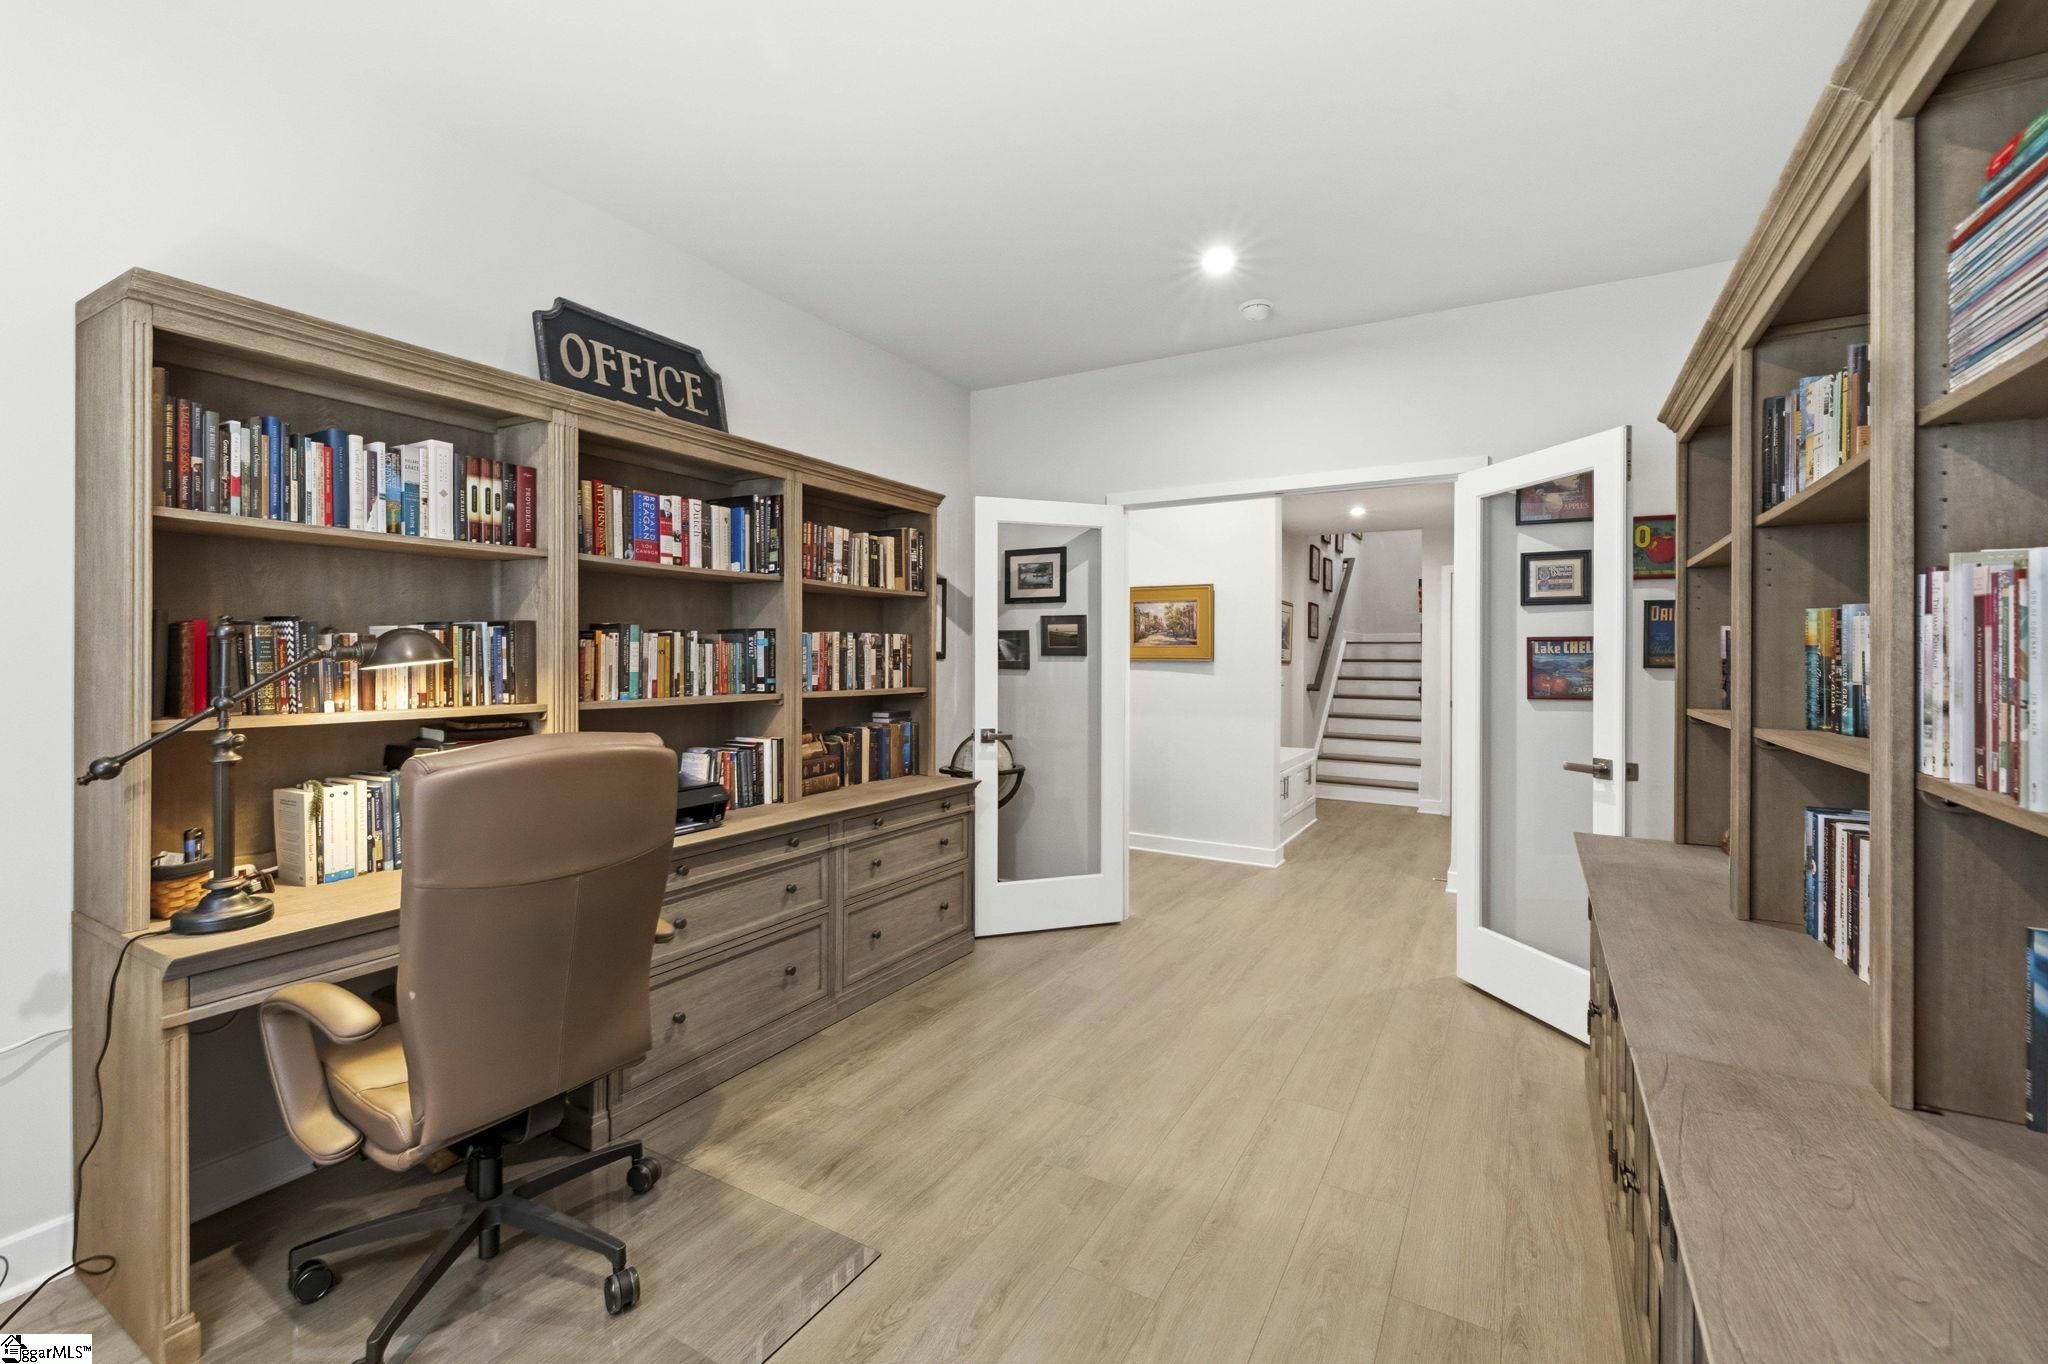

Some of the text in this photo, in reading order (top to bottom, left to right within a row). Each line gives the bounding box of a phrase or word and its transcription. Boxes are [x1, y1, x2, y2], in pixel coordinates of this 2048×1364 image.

[560, 333, 709, 416] OFFICE
[252, 425, 260, 445] Spurgeon
[180, 452, 190, 472] SONS
[597, 482, 604, 497] MY
[597, 500, 605, 527] TURN
[1563, 502, 1590, 510] APPLES
[693, 502, 701, 537] Dutch
[2031, 608, 2037, 617] OF
[1534, 641, 1561, 654] Lake
[1563, 640, 1593, 654] CHEL
[1932, 634, 1940, 669] KINKADE
